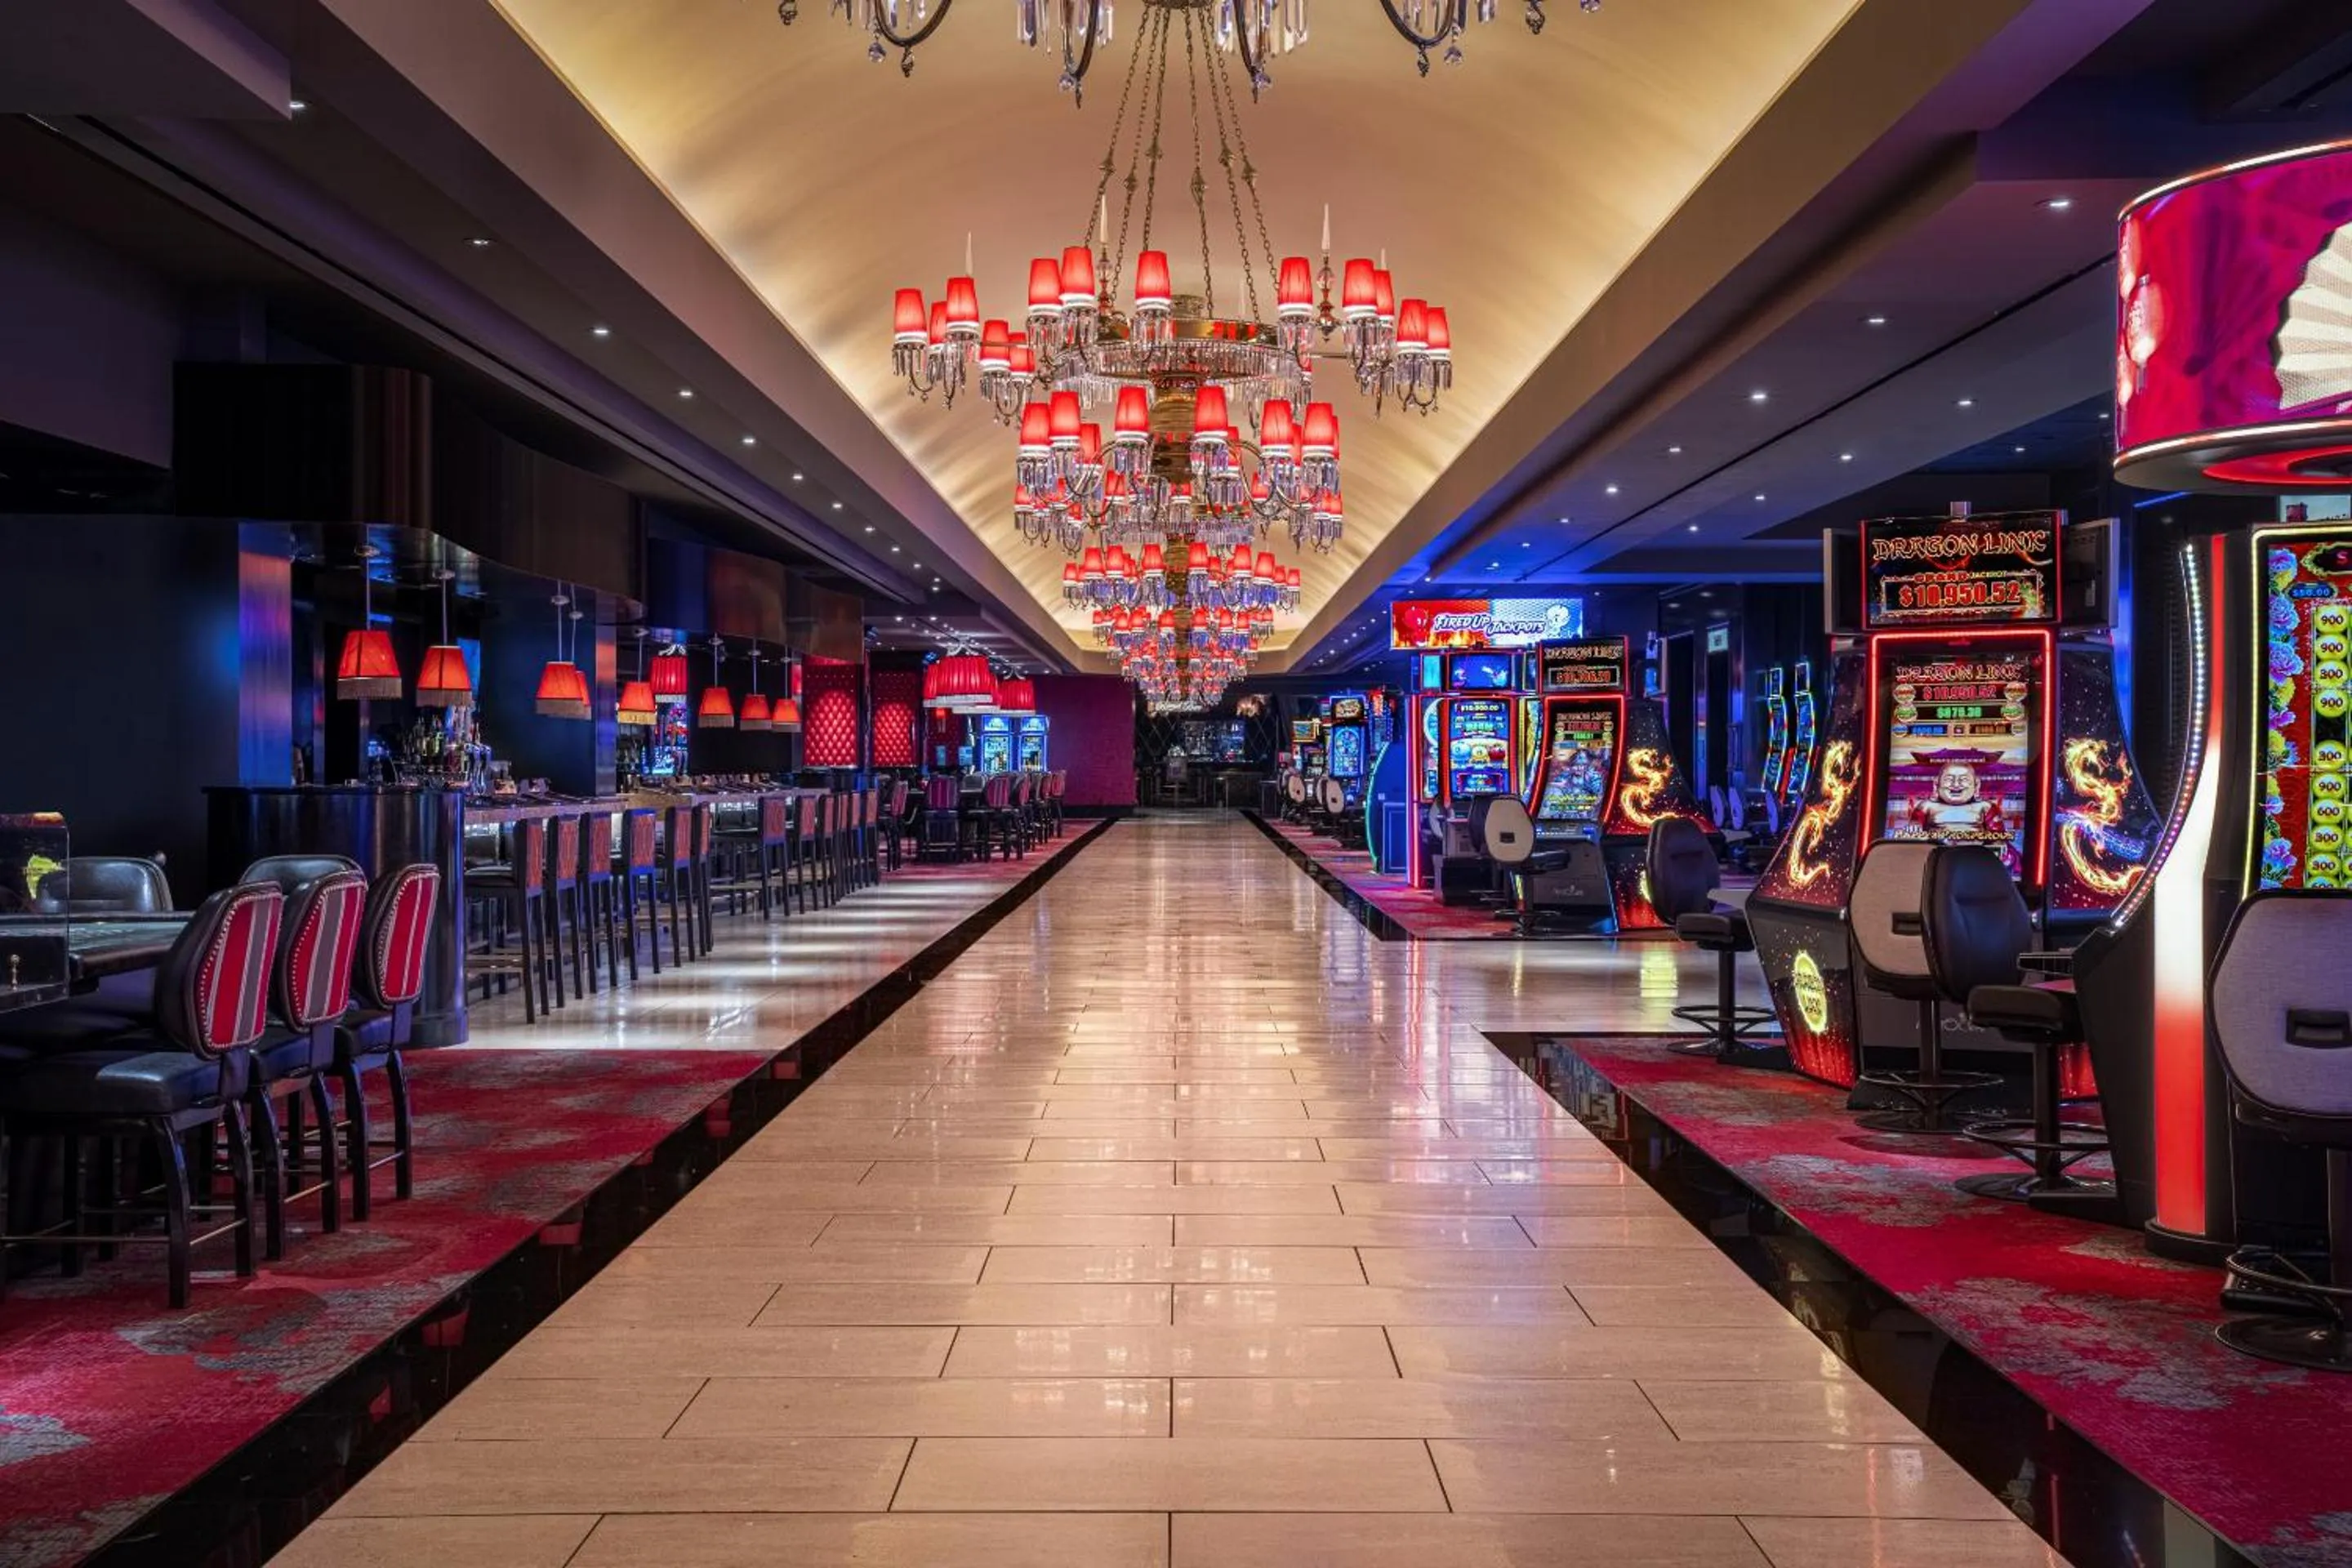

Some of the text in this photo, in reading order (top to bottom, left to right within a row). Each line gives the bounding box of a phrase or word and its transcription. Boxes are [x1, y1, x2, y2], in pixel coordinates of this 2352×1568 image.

[1873, 530, 2048, 561] DRAGON LINK
[1434, 614, 1546, 635] FIRED UP JACKPOTS
[2321, 614, 2344, 626] 900
